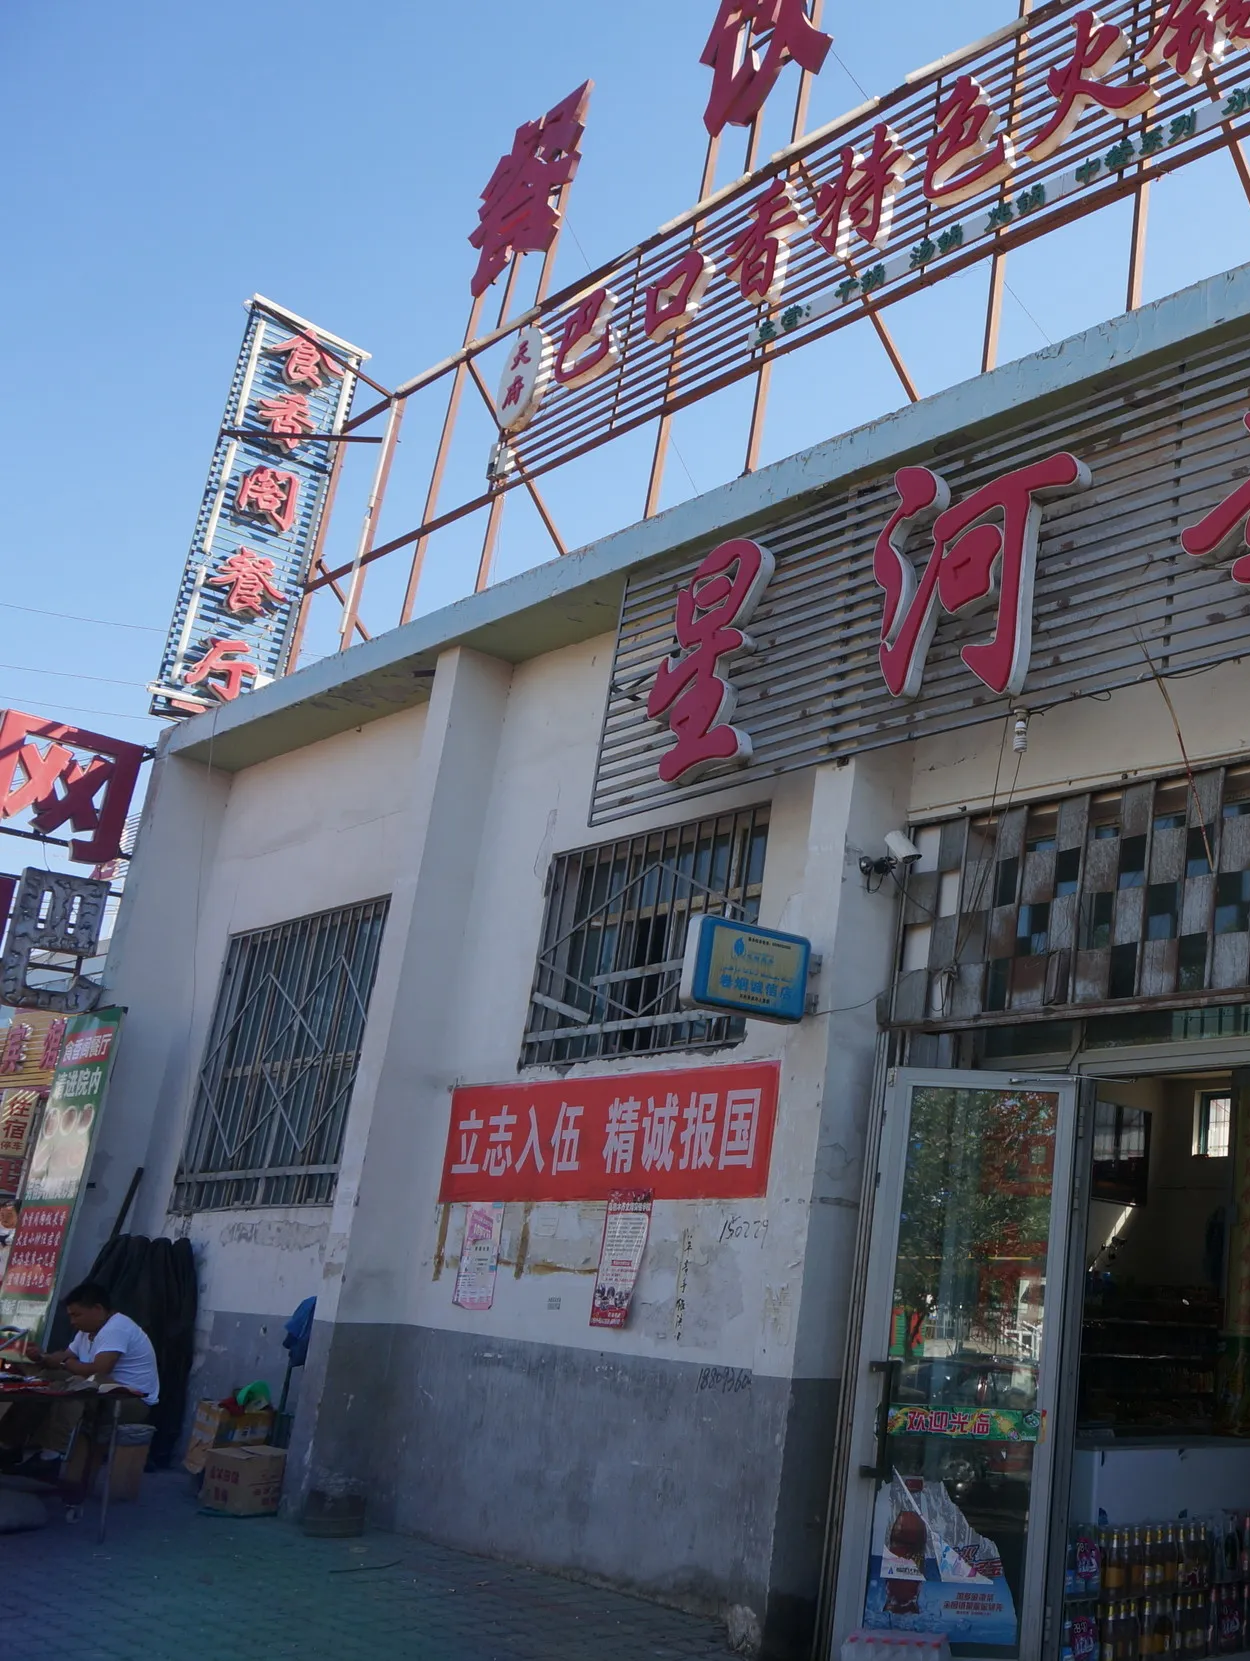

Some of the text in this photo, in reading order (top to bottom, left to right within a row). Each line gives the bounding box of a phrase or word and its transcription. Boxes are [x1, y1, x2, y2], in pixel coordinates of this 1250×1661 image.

[834, 263, 886, 303] 干锅
[909, 223, 963, 269] 汤锅
[451, 1088, 762, 1176] 立志入伍 精诚报国
[906, 1410, 992, 1435] 欢迎光临
